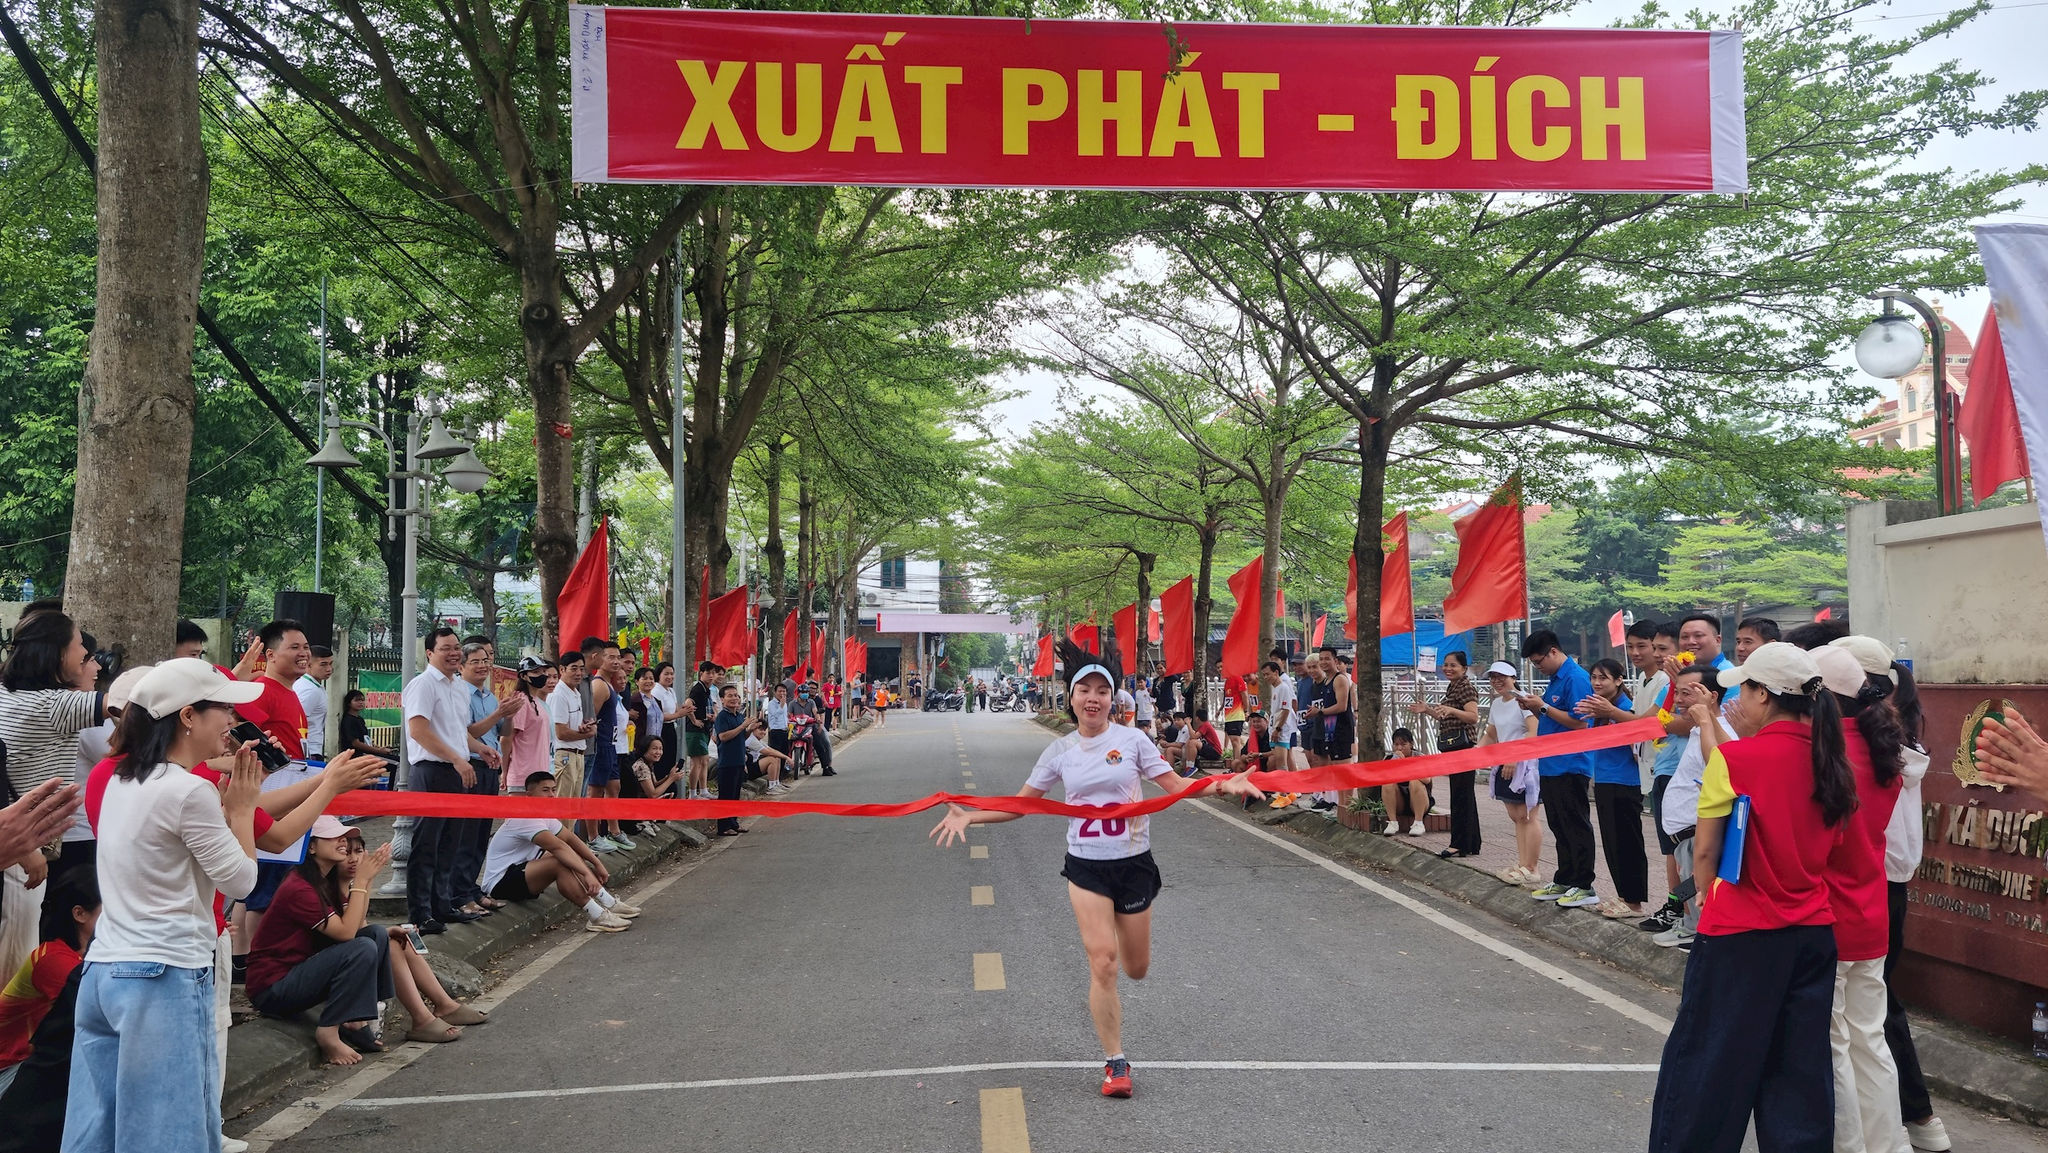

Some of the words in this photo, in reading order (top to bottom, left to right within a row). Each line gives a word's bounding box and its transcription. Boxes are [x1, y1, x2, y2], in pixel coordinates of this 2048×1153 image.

[675, 32, 963, 154] XUẤT
[1003, 52, 1280, 158] PHÁT
[1391, 56, 1647, 161] ĐÍCH
[1945, 798, 1979, 847] XÃ
[1950, 861, 2033, 900] COMMUNE
